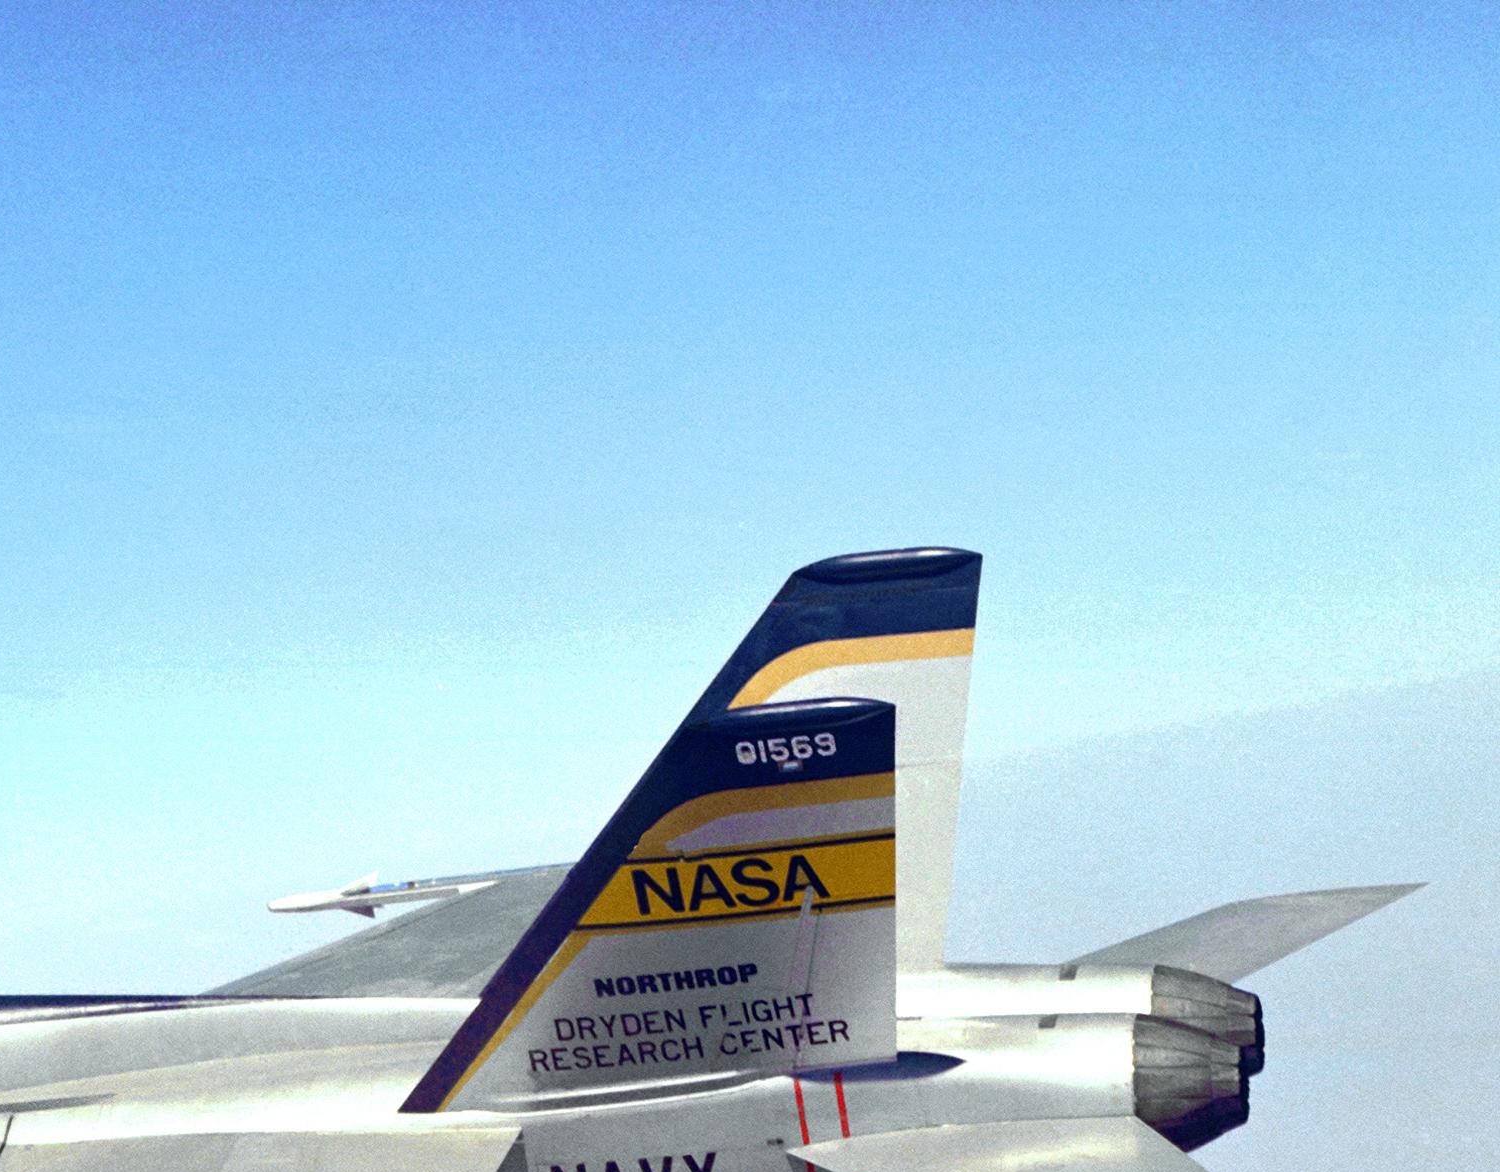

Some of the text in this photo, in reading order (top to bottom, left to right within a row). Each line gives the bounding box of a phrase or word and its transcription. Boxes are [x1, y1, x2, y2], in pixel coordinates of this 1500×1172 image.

[735, 732, 836, 765] 01569
[632, 855, 830, 915] NASA
[593, 964, 758, 998] NORTHROP
[554, 993, 813, 1041] DRYDEN FLIGHT
[528, 1020, 851, 1072] RESEARCH CENTER
